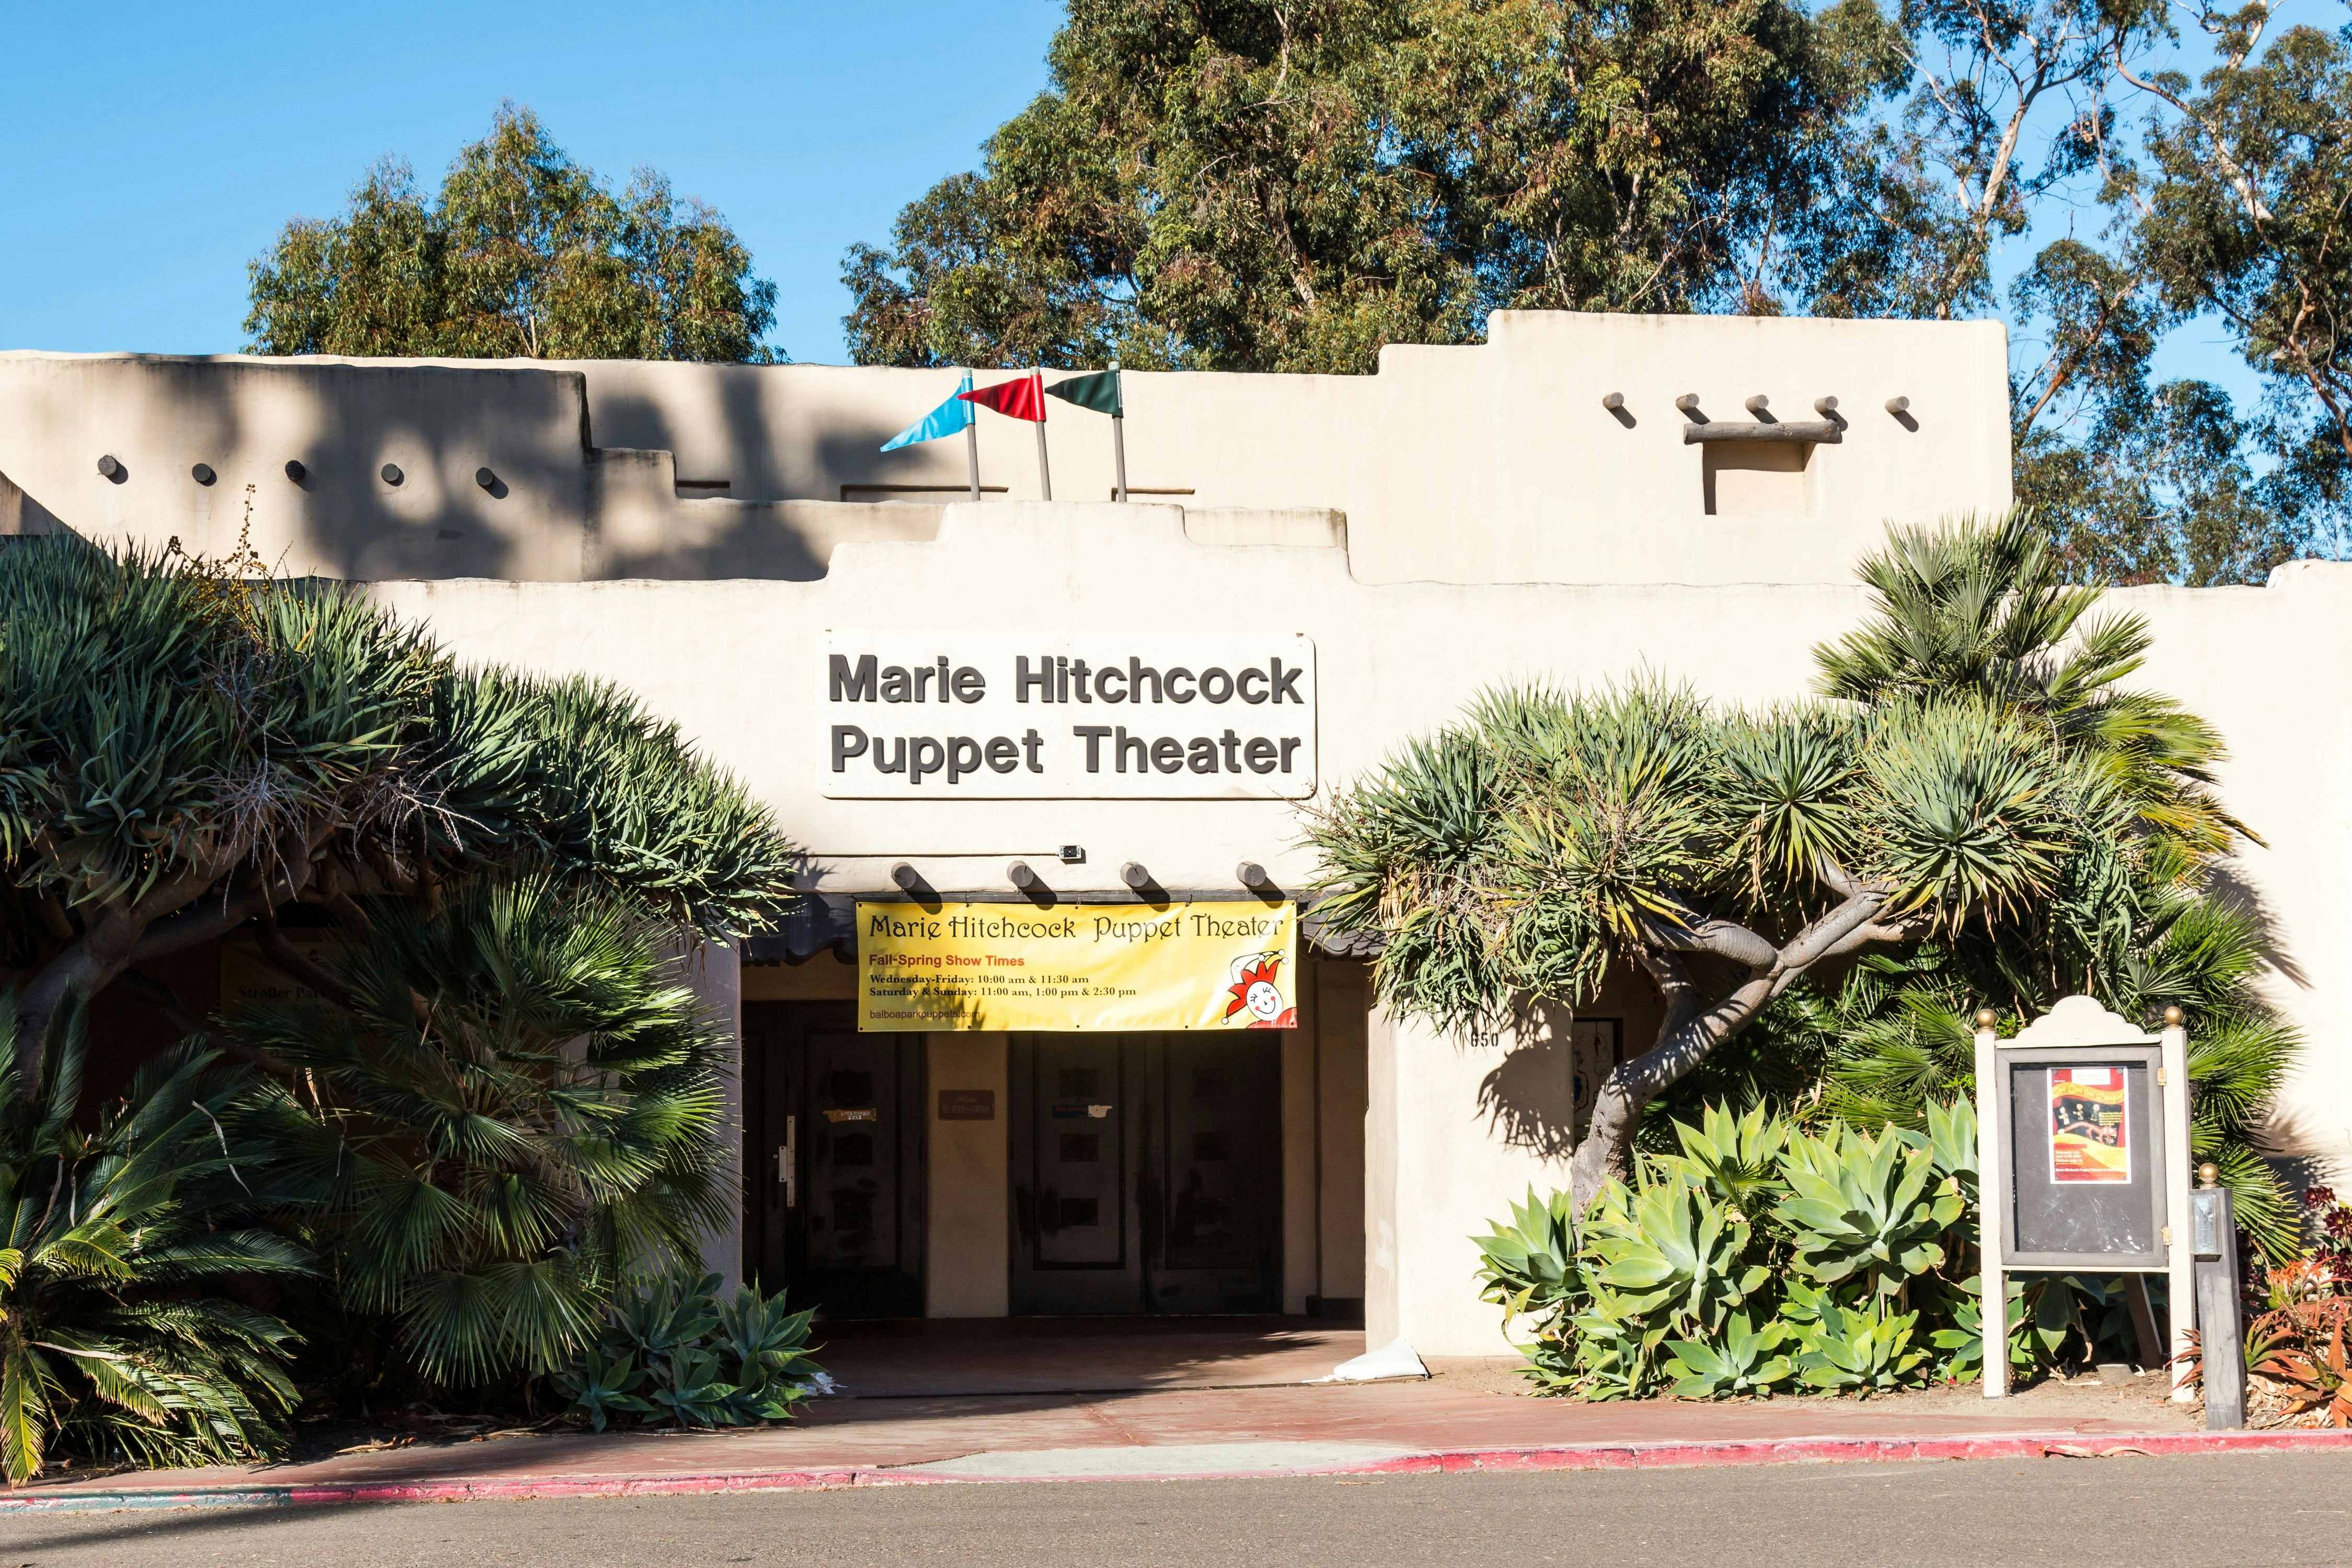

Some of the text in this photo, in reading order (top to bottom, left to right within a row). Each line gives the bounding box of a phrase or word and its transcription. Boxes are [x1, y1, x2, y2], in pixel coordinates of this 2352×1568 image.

[829, 655, 1304, 704] Marie Hitchcock
[832, 725, 1301, 785] Puppet Theater
[869, 914, 1283, 943] Marie Hitchcock Puppet Theater
[869, 954, 1024, 968] Fall-Spring Show Times
[870, 975, 974, 986] Wednesday-Friday:
[1029, 975, 1037, 984] &
[238, 986, 291, 998] Stroller
[870, 987, 919, 998] Saturday
[921, 987, 930, 996] &
[933, 987, 977, 998] Sunday:
[982, 987, 1008, 996] 11:00
[1093, 987, 1115, 996] 2:30
[1118, 989, 1136, 998] pm
[870, 1010, 980, 1020] balboaparkpuppets.com
